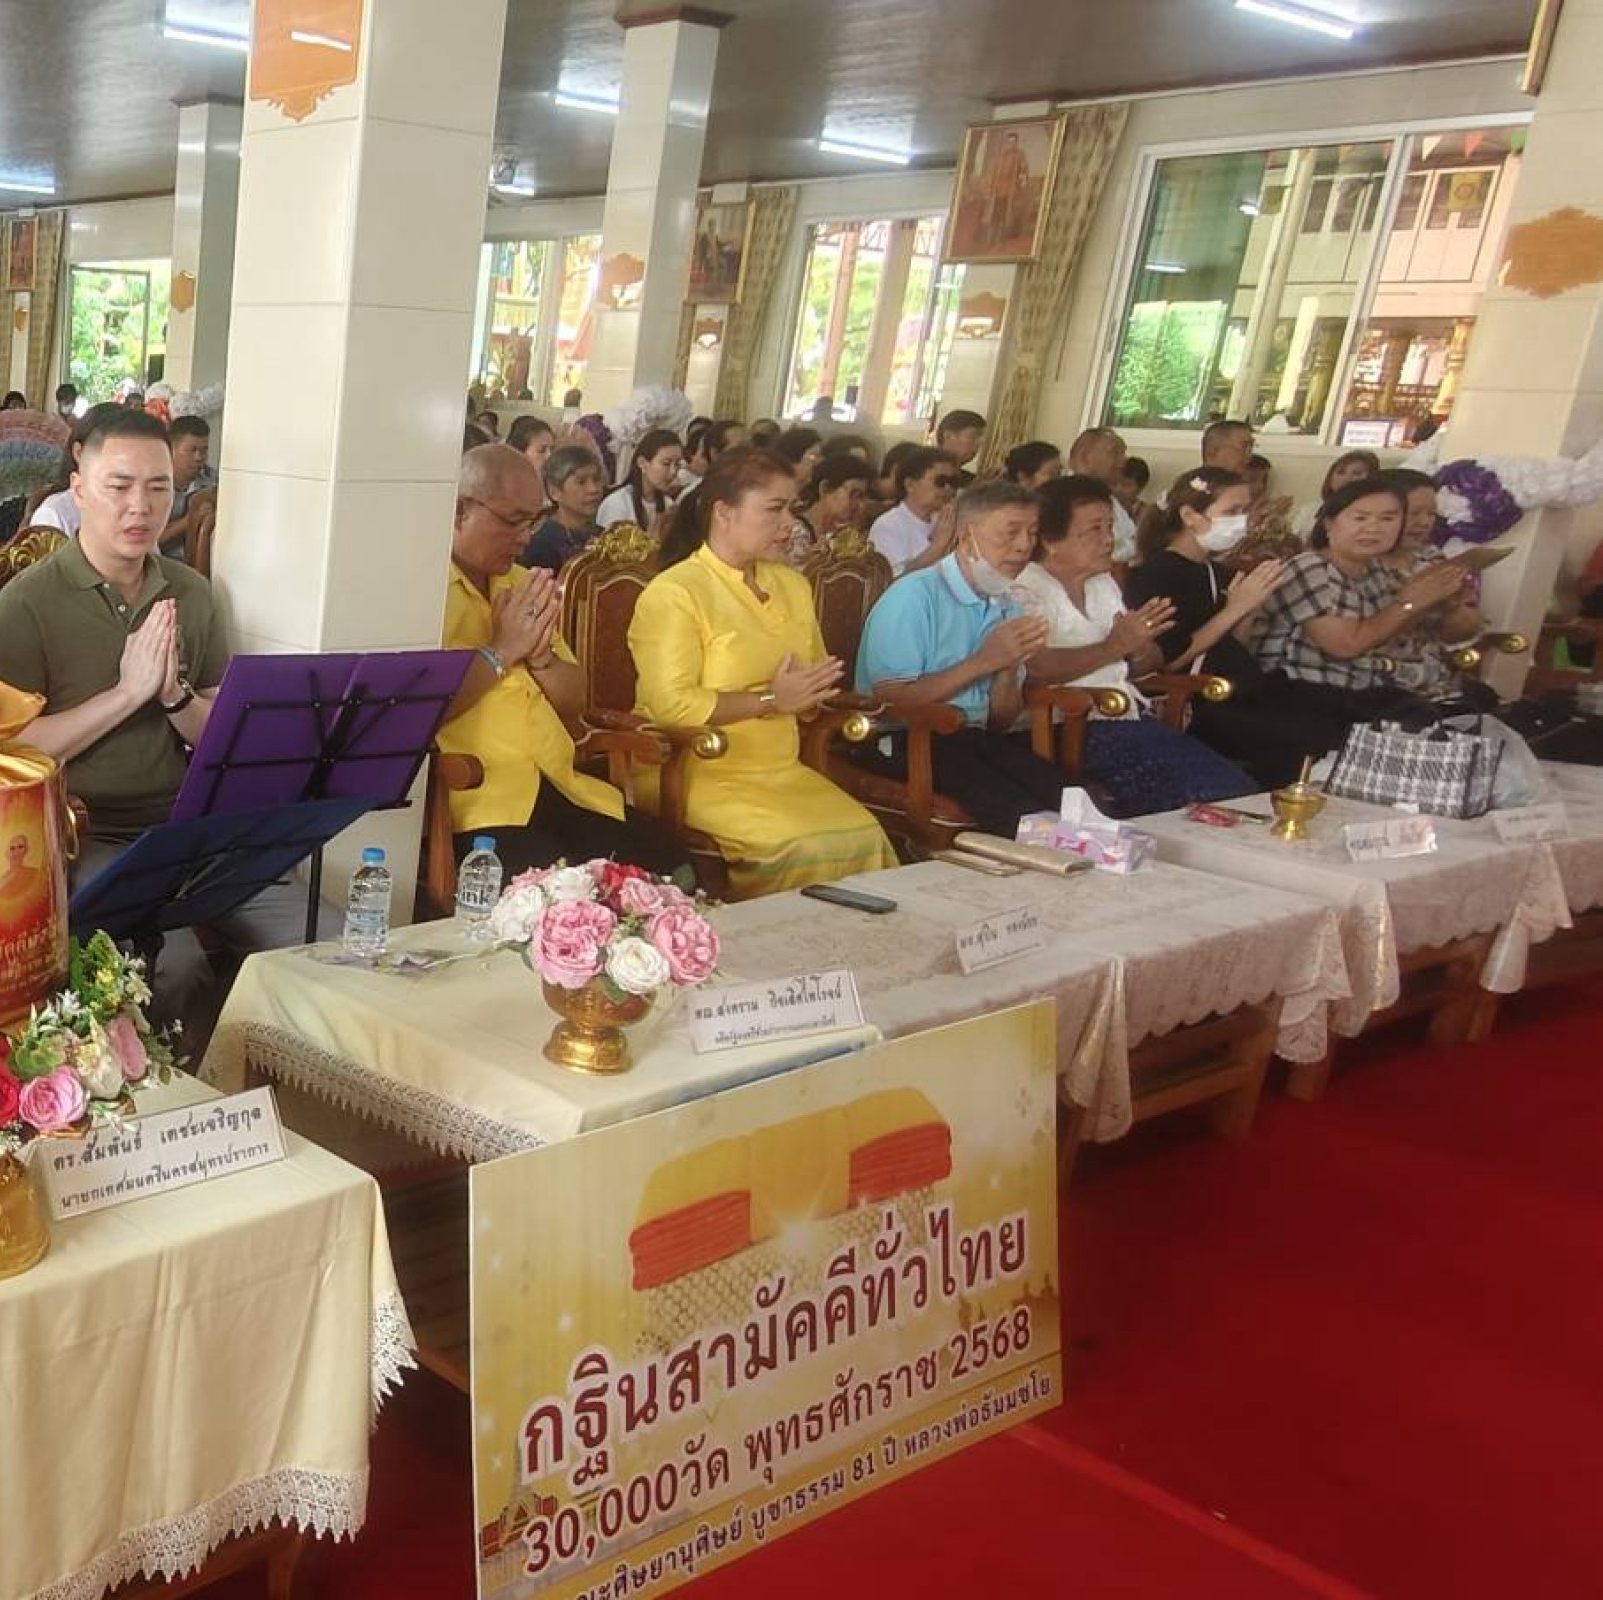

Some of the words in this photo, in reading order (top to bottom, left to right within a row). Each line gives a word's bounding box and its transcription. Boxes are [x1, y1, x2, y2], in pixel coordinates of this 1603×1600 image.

[524, 1206, 1027, 1486] กฐินสามัคคีทั่วไทย
[743, 1350, 938, 1485] พุทธศักราช
[950, 1308, 1031, 1379] 2568
[751, 1468, 845, 1540] บูชาธรรม
[852, 1452, 875, 1481] 81
[883, 1435, 897, 1466] ปี
